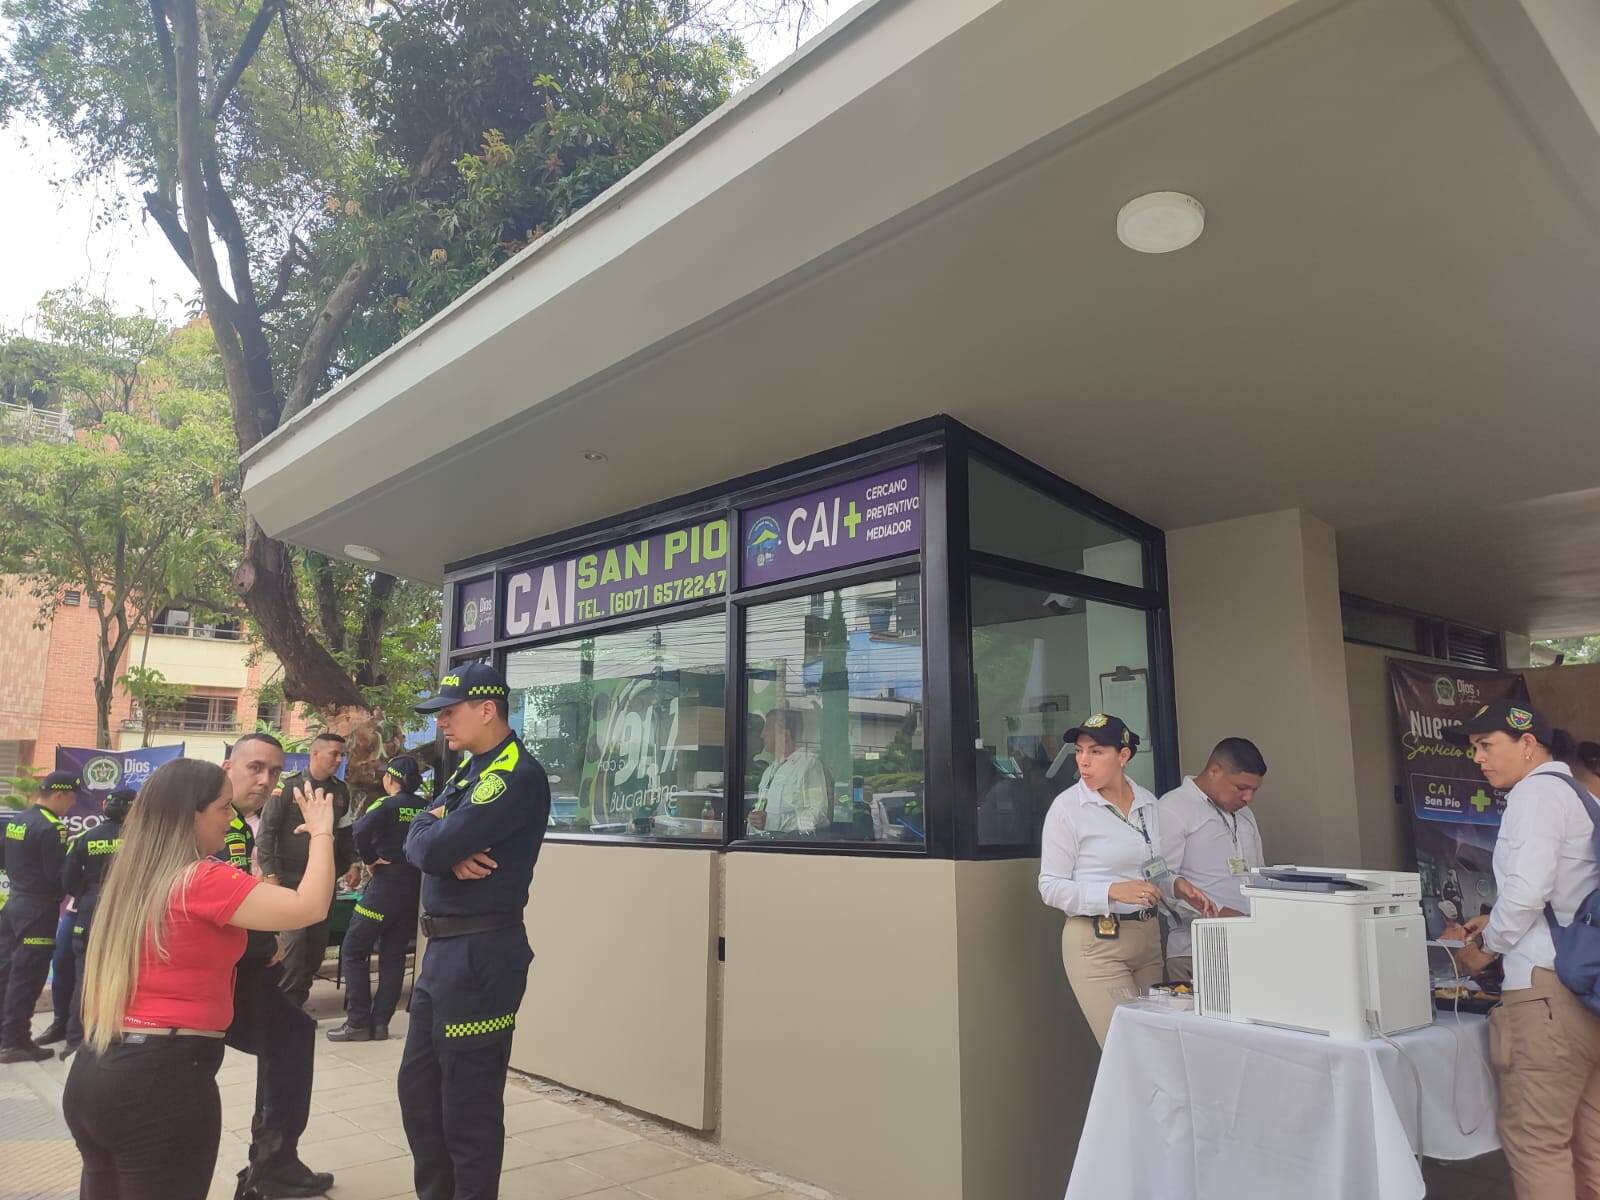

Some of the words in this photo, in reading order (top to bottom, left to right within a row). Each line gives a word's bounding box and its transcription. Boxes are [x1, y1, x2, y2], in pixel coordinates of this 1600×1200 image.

[866, 478, 908, 500] CERCANO
[866, 496, 919, 521] PREVENTIVO
[866, 519, 912, 541] MEDIADOR
[577, 540, 649, 590] SAN
[664, 519, 728, 570] PIO
[506, 559, 577, 635] CAI
[577, 598, 605, 621] TEL.
[653, 570, 727, 605] 6572247
[1456, 679, 1475, 694] Dios
[1410, 710, 1463, 740] Nue
[1402, 731, 1464, 760] Servicio
[124, 758, 150, 773] Dios
[1425, 795, 1442, 806] San
[1428, 783, 1452, 795] CAI
